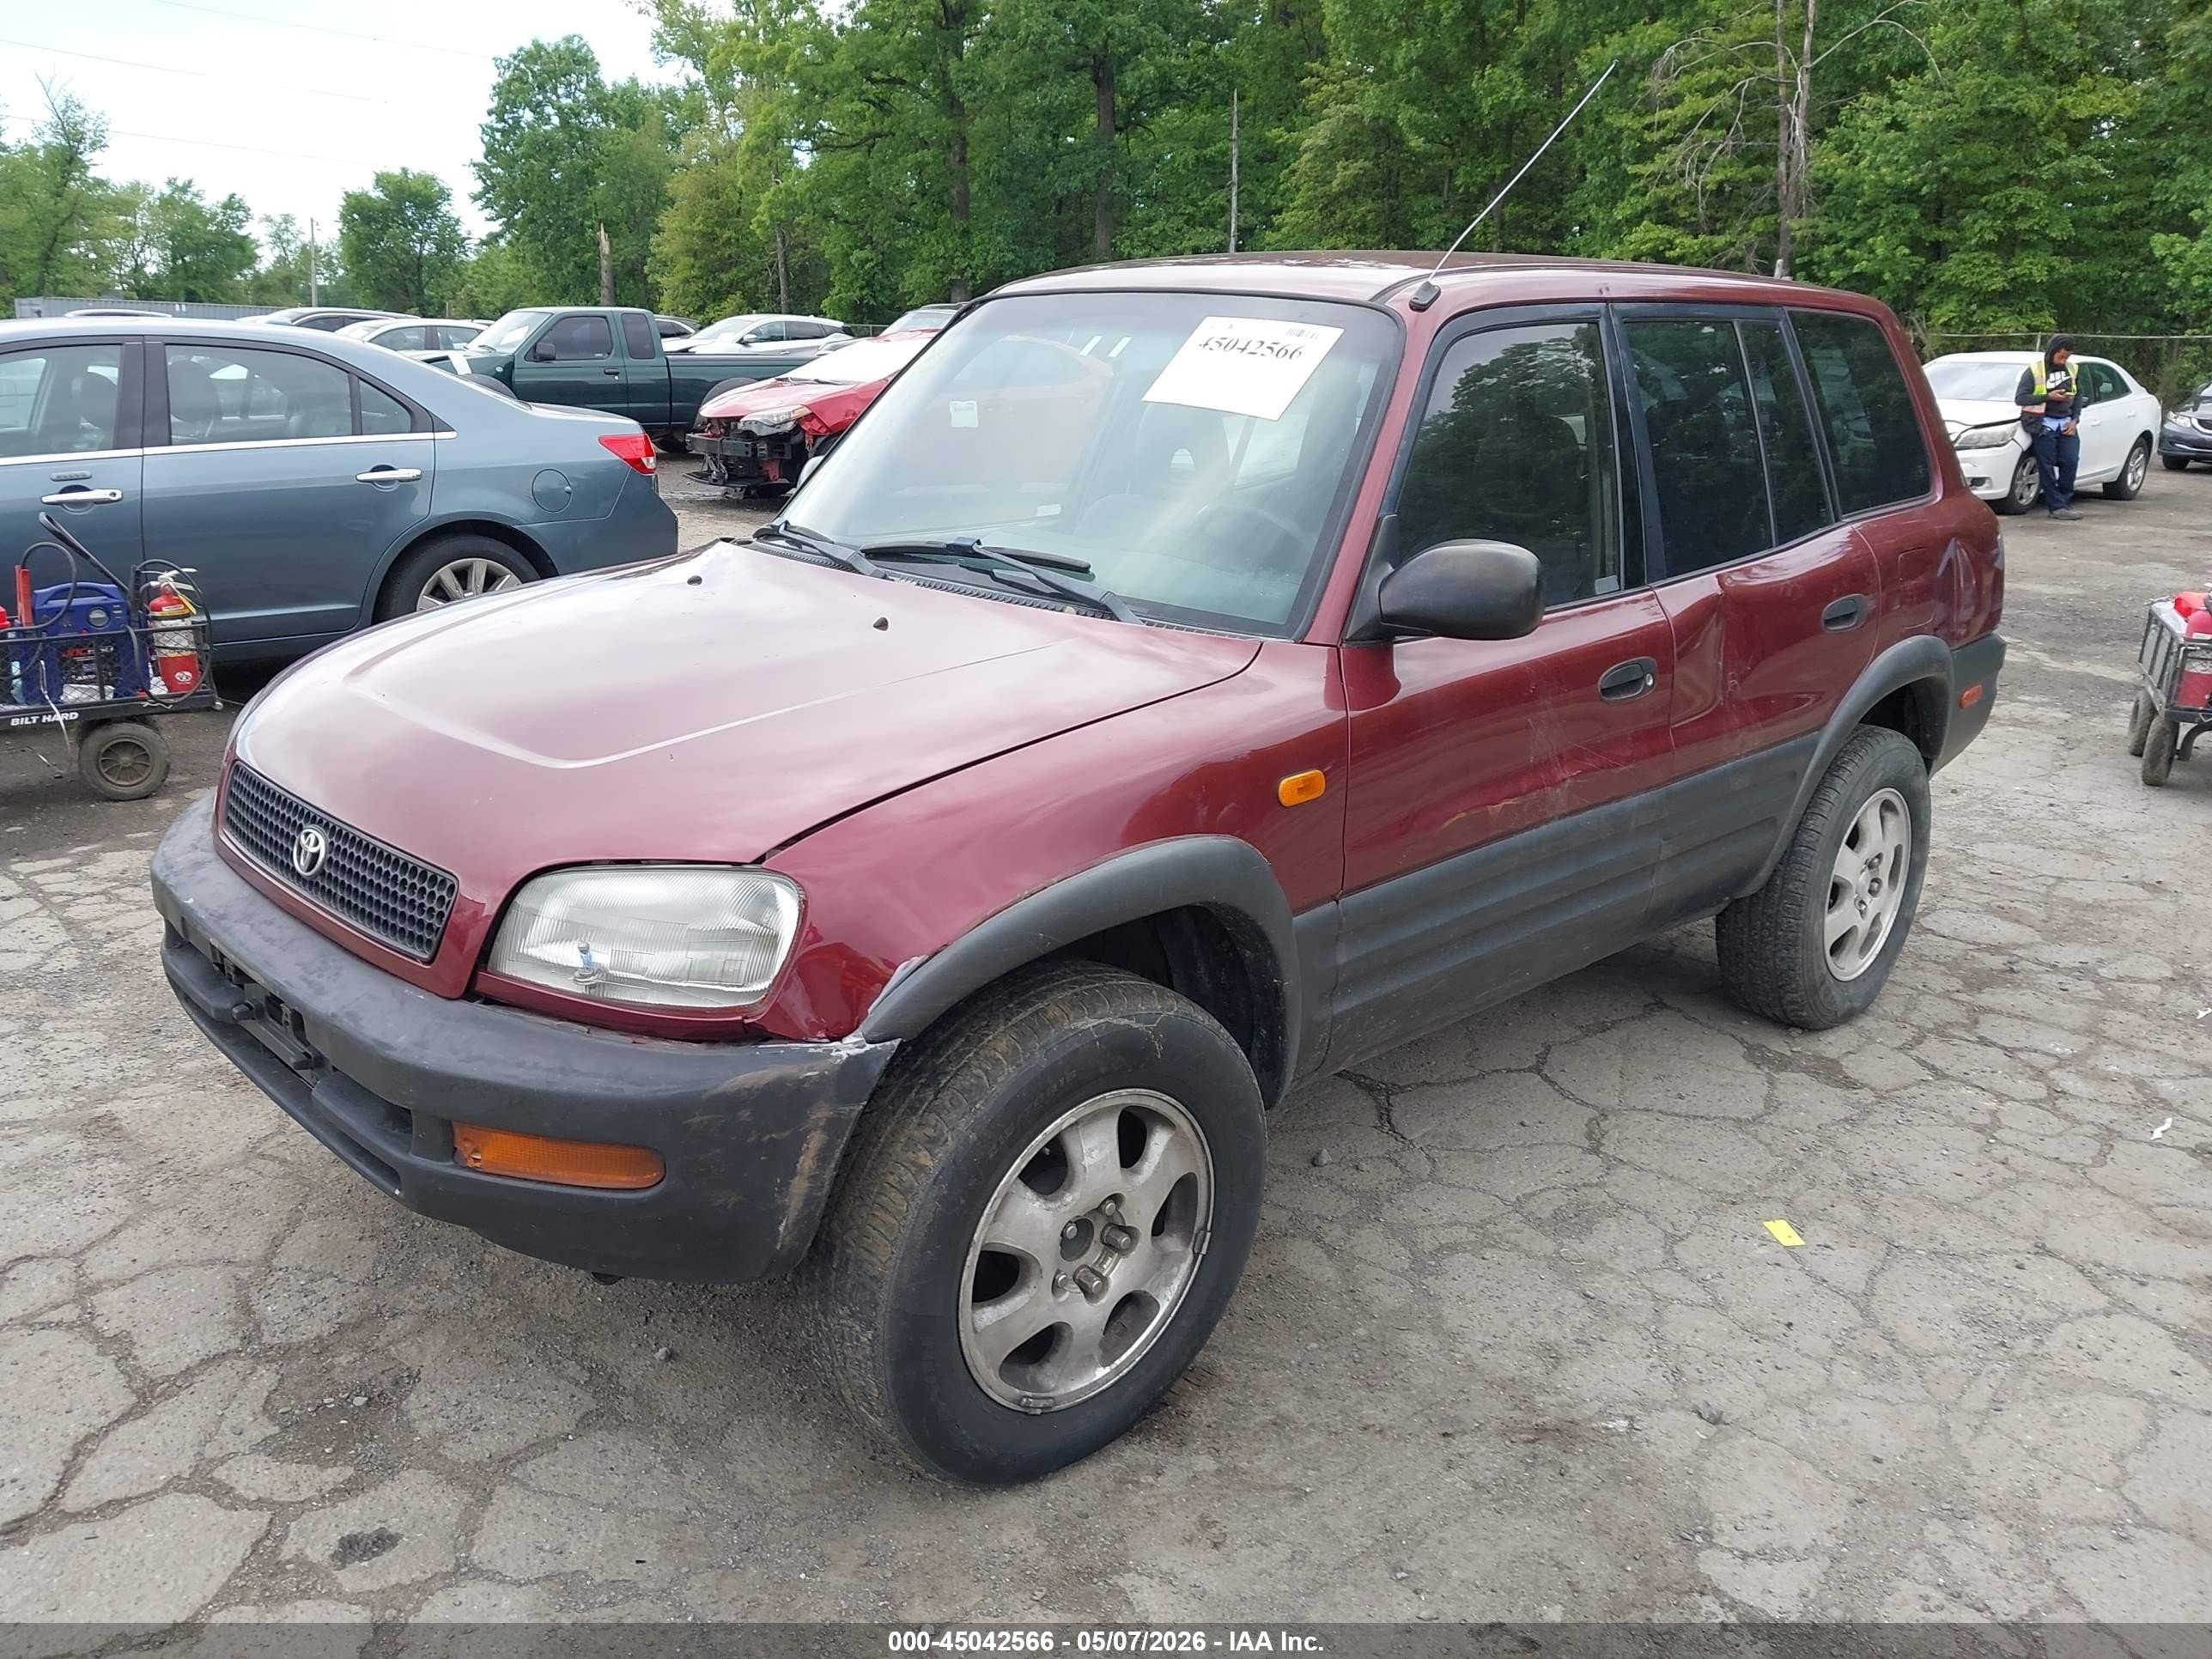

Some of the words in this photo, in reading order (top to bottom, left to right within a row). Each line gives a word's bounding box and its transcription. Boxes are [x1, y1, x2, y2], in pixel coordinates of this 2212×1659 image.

[1199, 336, 1305, 361] 45042566
[10, 715, 40, 726] BILT
[42, 712, 80, 724] HARD
